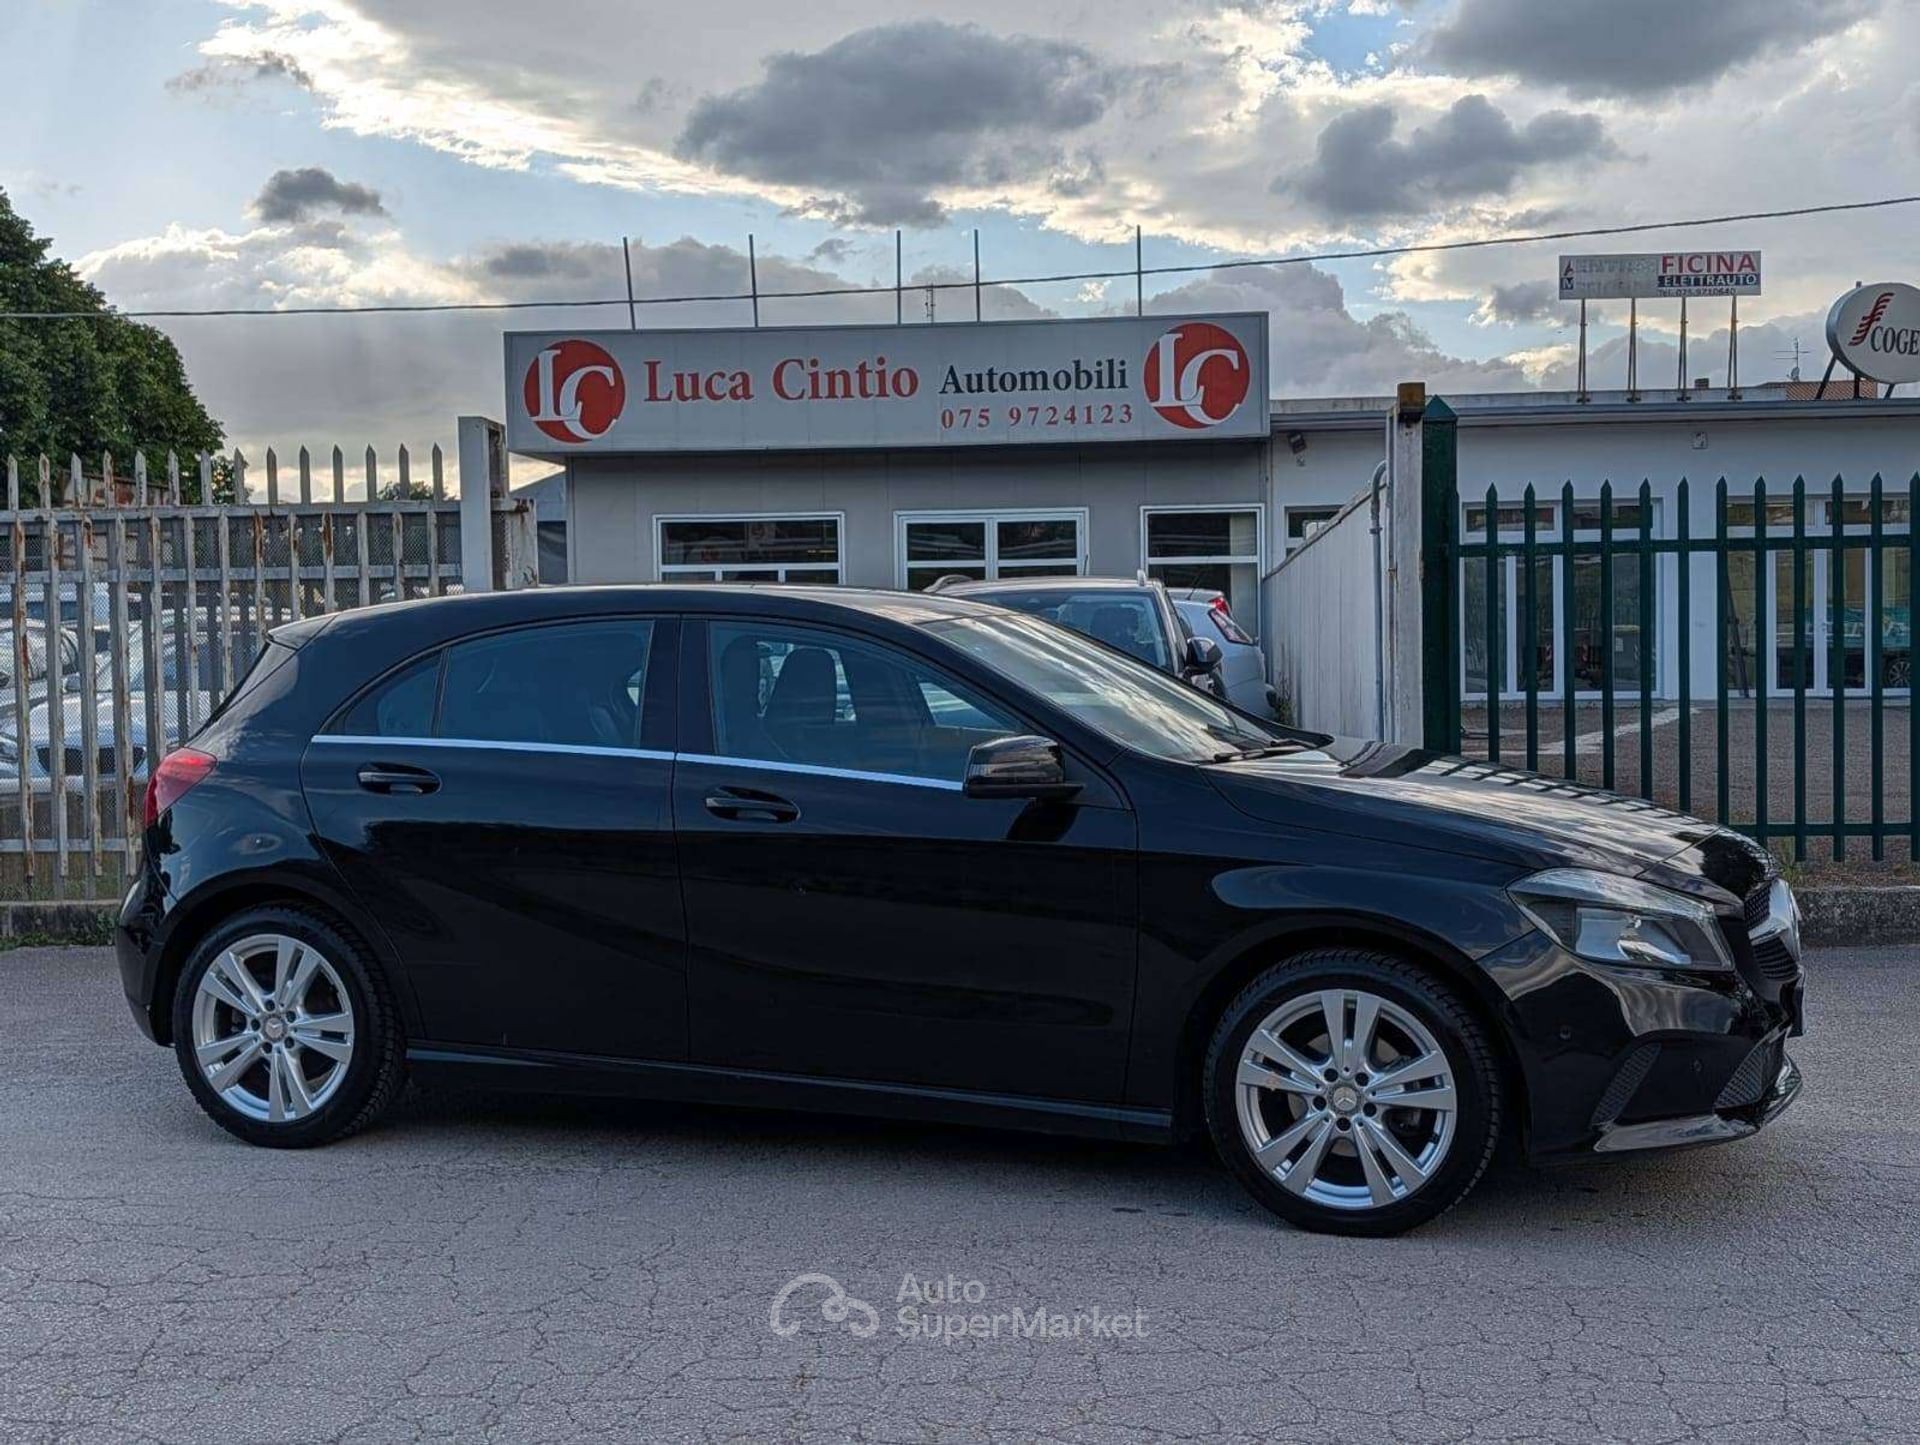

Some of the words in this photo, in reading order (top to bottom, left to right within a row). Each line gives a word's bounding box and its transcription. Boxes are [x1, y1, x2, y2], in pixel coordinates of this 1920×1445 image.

[1661, 253, 1756, 273] FICINA
[1664, 274, 1757, 287] ELETTRAUTO
[643, 360, 754, 402] Luca
[772, 356, 919, 401] Cintio
[938, 358, 1129, 395] Automobili
[940, 407, 991, 429] 075
[1008, 403, 1133, 427] 9724123
